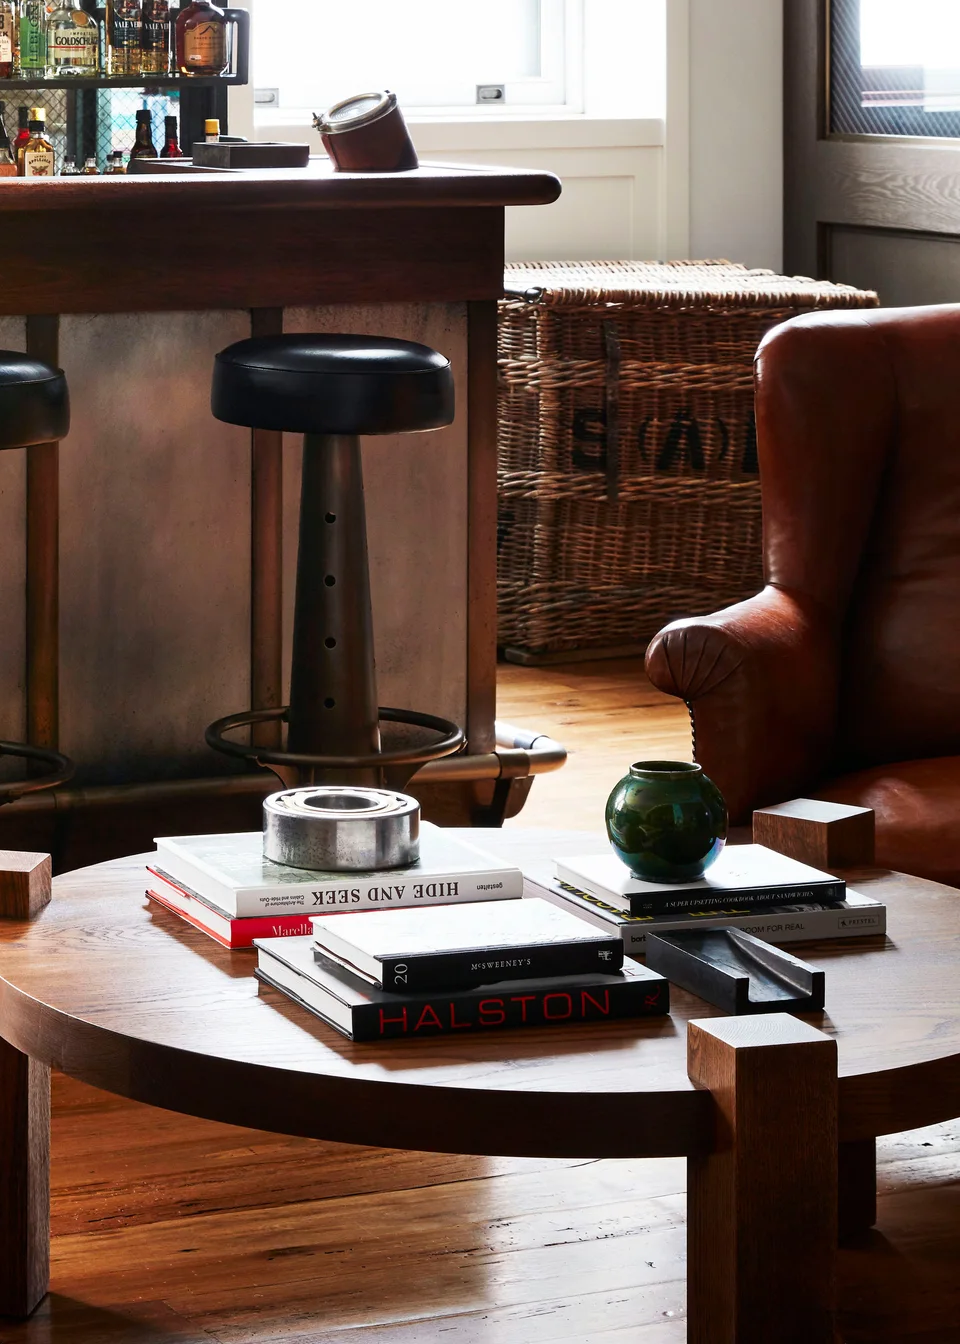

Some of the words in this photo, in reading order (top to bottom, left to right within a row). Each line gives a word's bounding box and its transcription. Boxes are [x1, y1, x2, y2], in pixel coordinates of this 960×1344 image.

[29, 4, 39, 62] LEBLON
[368, 885, 405, 901] AND
[412, 882, 458, 898] HIDE
[477, 882, 503, 890] gestalten
[312, 888, 360, 906] SEEK
[272, 923, 313, 937] Marella
[394, 963, 408, 984] 20
[379, 990, 610, 1034] HALSTON
